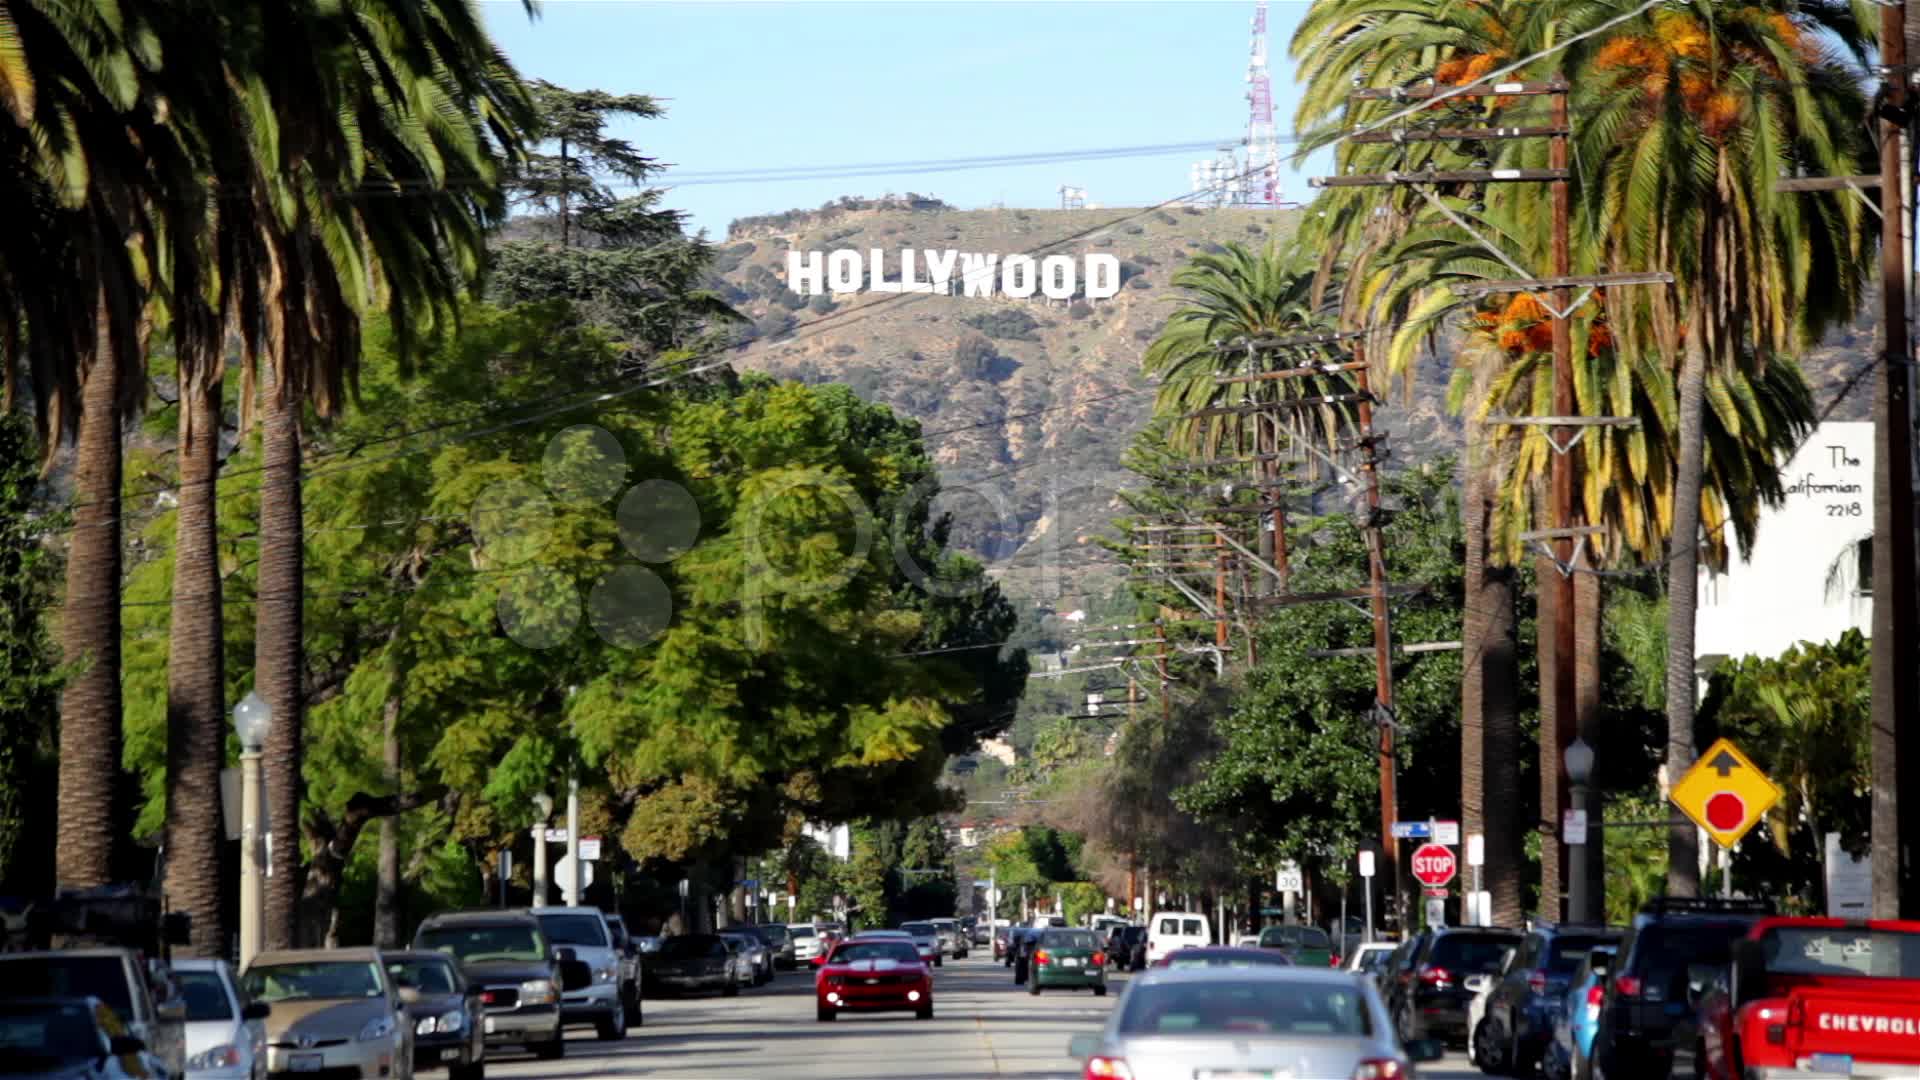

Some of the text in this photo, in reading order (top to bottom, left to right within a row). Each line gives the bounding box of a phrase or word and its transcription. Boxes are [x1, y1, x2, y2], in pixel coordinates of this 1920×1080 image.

[787, 248, 1121, 300] HOLLYWOOD
[1825, 445, 1861, 468] The
[1781, 472, 1863, 498] alifornian
[1825, 501, 1863, 517] 2218
[1415, 856, 1452, 873] STOP
[1281, 877, 1298, 889] 30
[1818, 1012, 1920, 1035] CHEVROL
